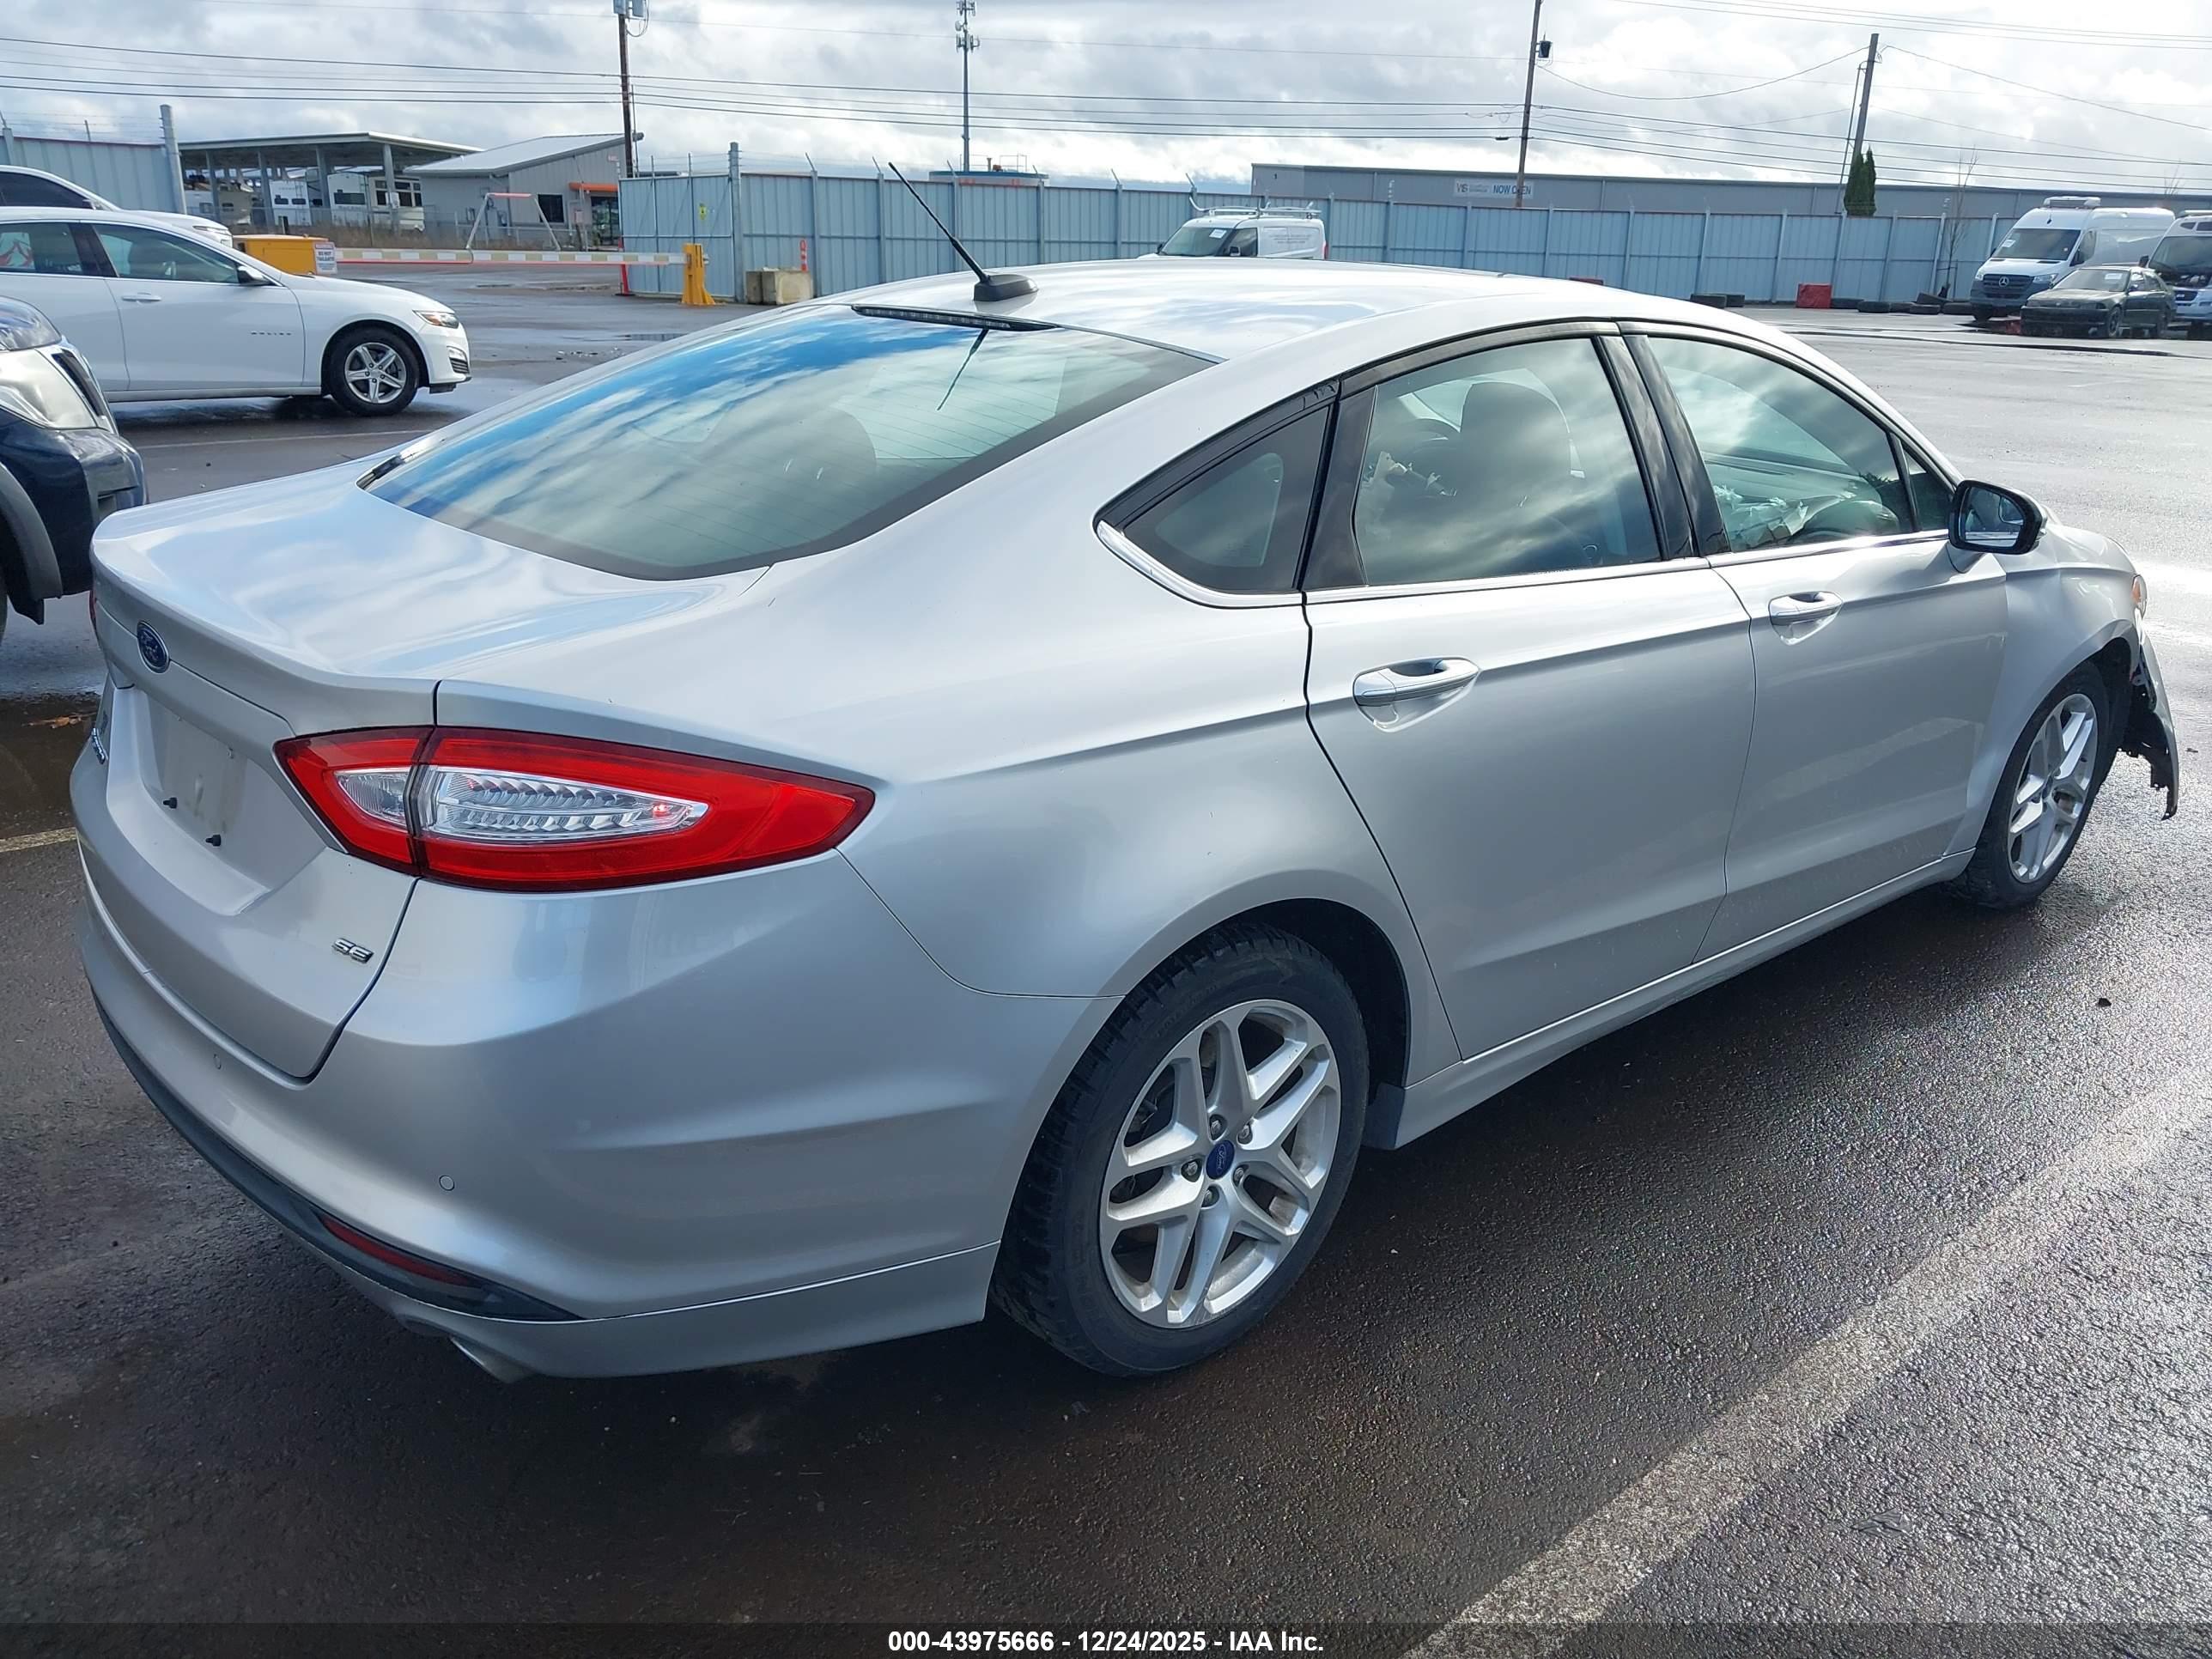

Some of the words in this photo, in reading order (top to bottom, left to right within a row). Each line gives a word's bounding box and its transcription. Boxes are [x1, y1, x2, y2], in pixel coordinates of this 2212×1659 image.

[1493, 185, 1511, 195] NOW
[1511, 185, 1532, 195] OEN
[333, 938, 374, 963] SE
